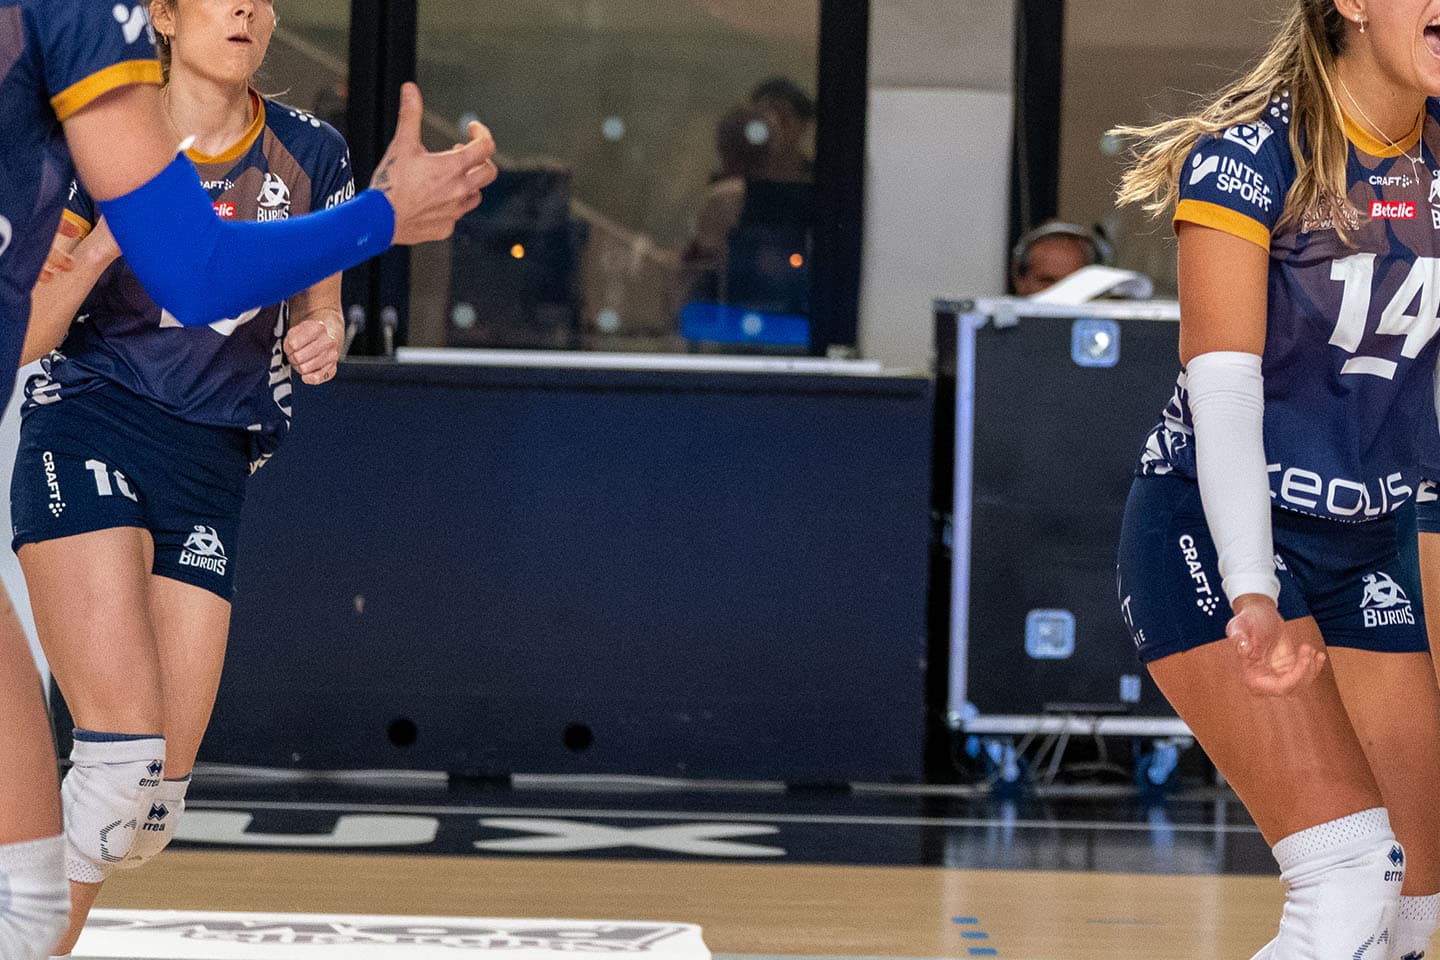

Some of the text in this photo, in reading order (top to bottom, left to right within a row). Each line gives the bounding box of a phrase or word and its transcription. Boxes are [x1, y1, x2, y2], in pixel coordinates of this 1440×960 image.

[1216, 173, 1273, 212] SPORT
[1368, 174, 1402, 187] CRAFT
[1371, 202, 1415, 218] Betclic
[42, 451, 62, 502] CRAFT
[178, 549, 227, 576] BURDIS
[1179, 534, 1212, 596] CRAFT
[1363, 604, 1416, 628] BURDIS
